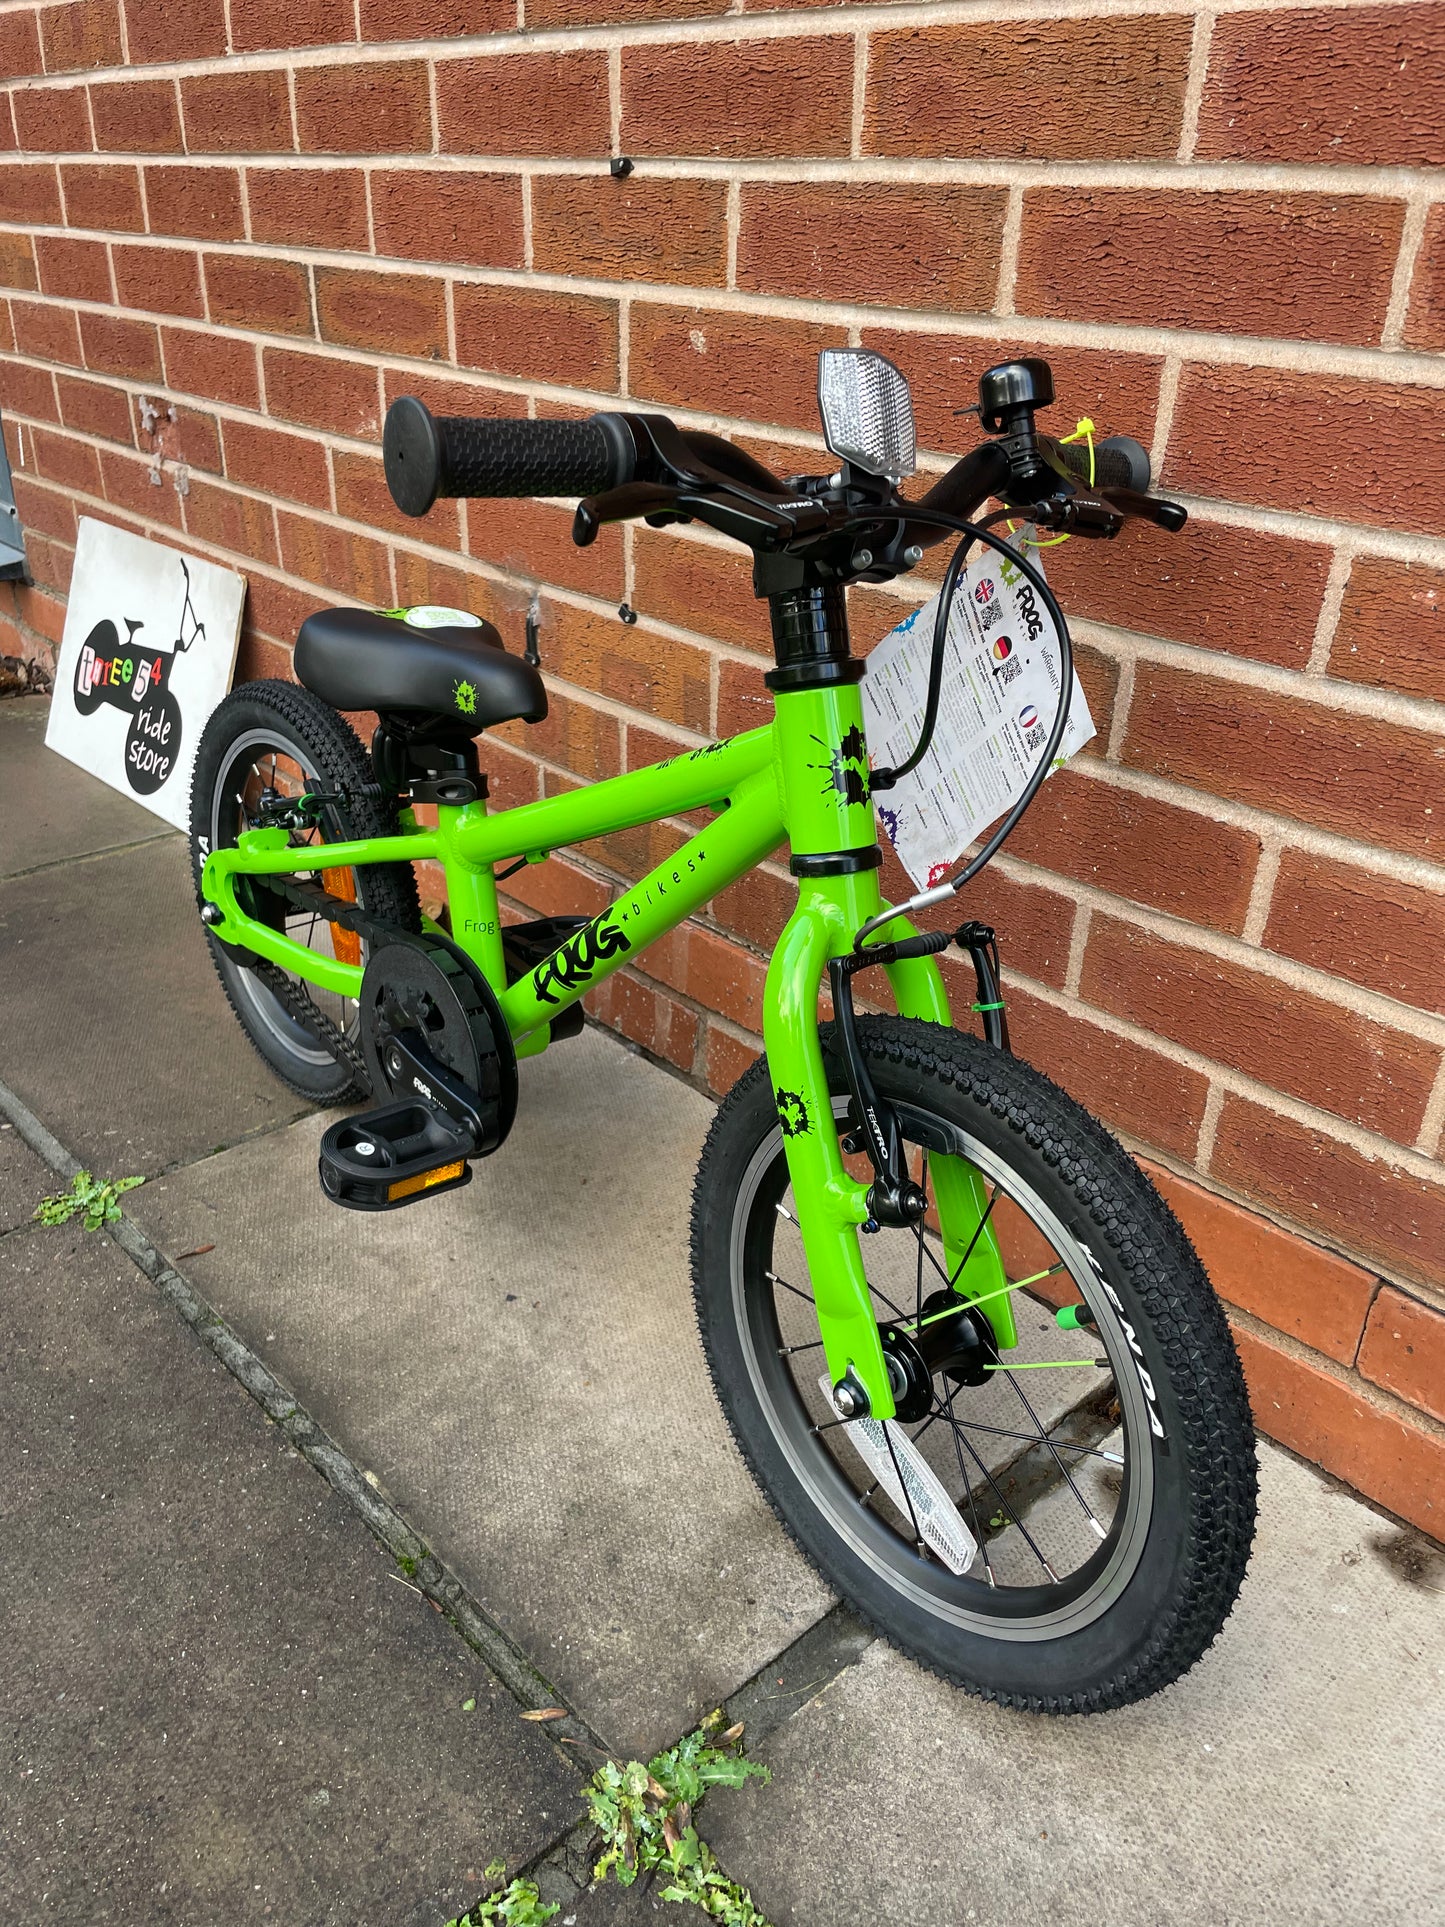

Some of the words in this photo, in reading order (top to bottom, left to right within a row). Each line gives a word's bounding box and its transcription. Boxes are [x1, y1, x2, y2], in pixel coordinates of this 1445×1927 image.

[1016, 584, 1043, 641] FROG
[1040, 646, 1060, 691] WARRANTY
[136, 706, 171, 746] ride
[128, 739, 170, 781] store
[632, 858, 696, 916] bikes
[464, 919, 495, 935] Frog
[533, 906, 632, 1004] FROG
[866, 1106, 888, 1160] TEKTRO
[1076, 1240, 1164, 1438] KENDA
